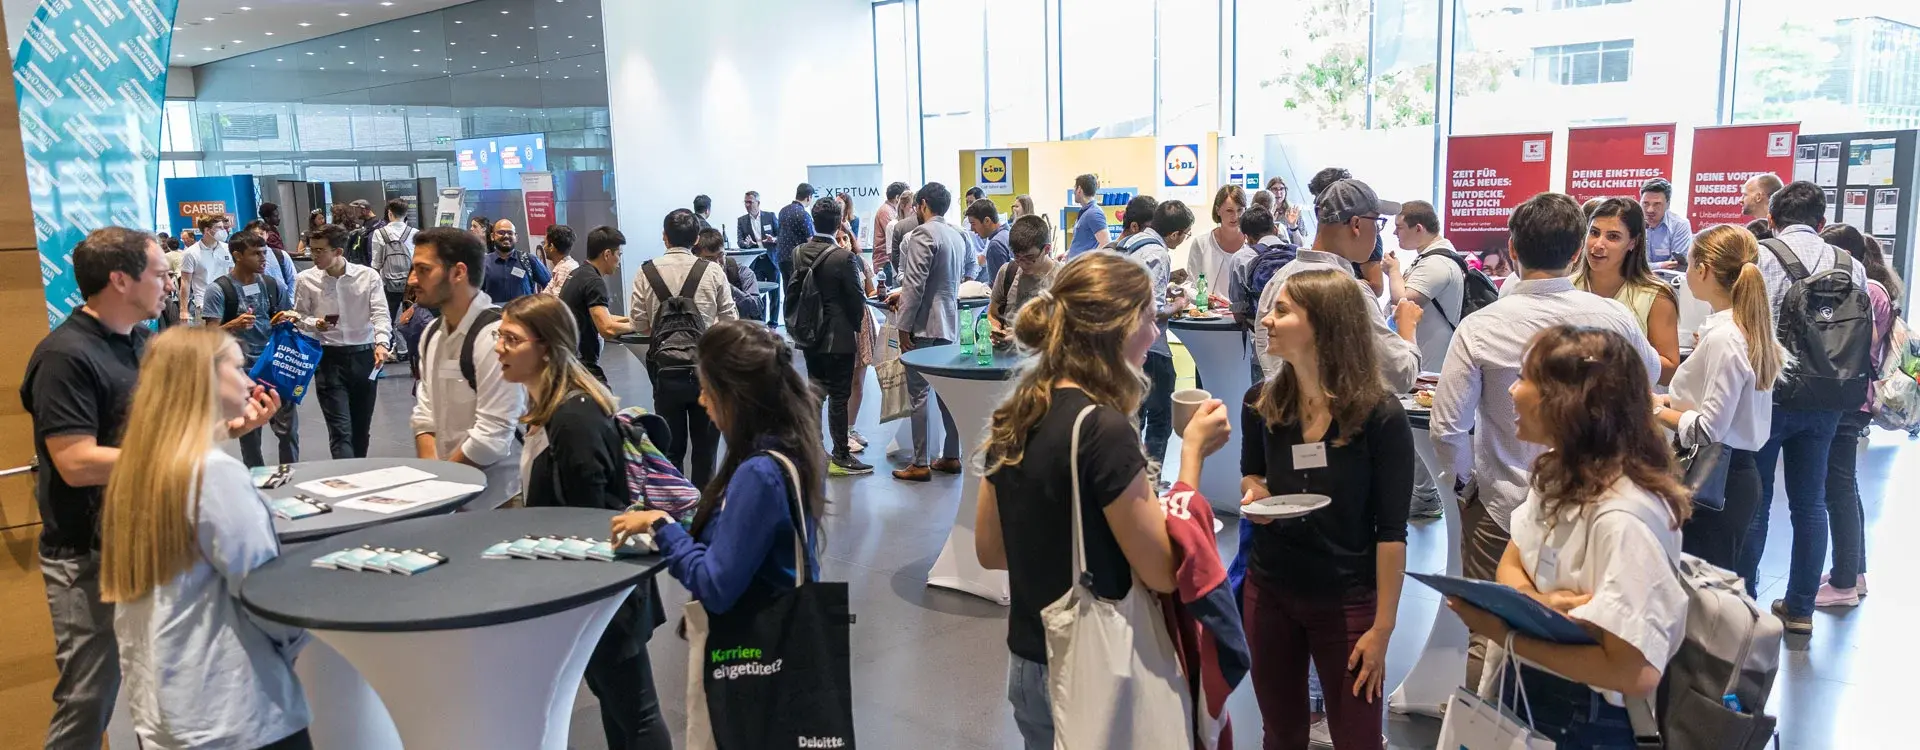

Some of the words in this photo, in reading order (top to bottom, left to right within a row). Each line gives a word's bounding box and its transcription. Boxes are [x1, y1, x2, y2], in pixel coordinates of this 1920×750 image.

[1452, 170, 1474, 178] ZEIT
[1476, 168, 1496, 178] FÜR
[1572, 170, 1603, 178] DEINE
[1605, 168, 1664, 177] EINSTIEGS-
[1696, 173, 1724, 181] DEINE
[1477, 178, 1512, 186] NEUES:
[1695, 185, 1737, 193] UNSERES
[1452, 190, 1505, 199] ENTDECKE,
[183, 204, 225, 214] CAREER
[285, 355, 314, 369] CHANCEN
[273, 360, 306, 376] ERGREIFEN
[712, 646, 762, 662] Karriere
[713, 659, 783, 679] eingetütet?
